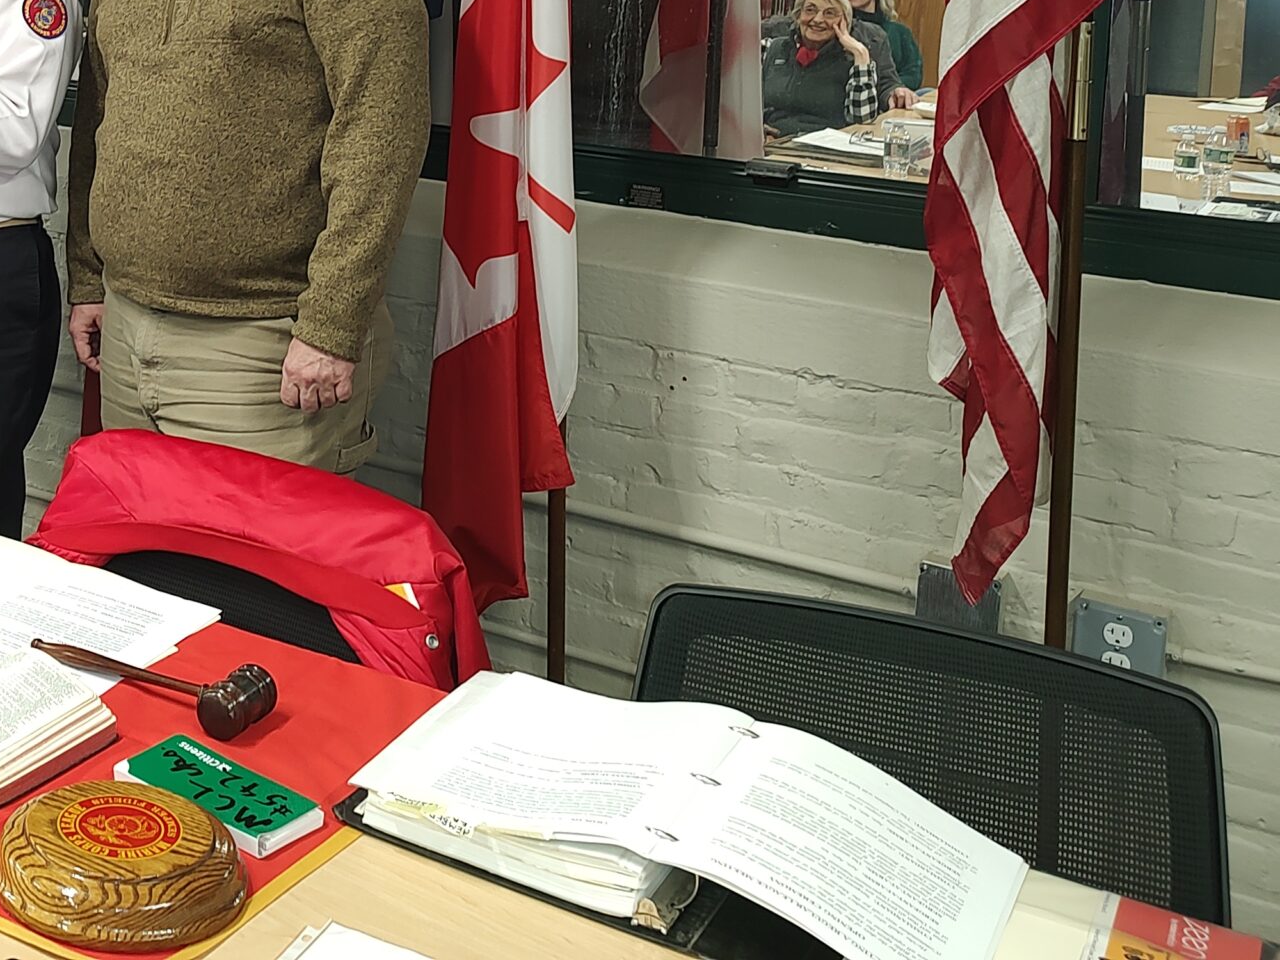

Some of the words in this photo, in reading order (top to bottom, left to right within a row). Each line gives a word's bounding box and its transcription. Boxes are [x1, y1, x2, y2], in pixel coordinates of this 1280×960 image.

[91, 797, 146, 808] FIDELIS
[60, 803, 87, 833] LEAGUE
[150, 805, 177, 838] SEMPER
[68, 834, 110, 857] CORPS
[117, 840, 172, 859] MARINE
